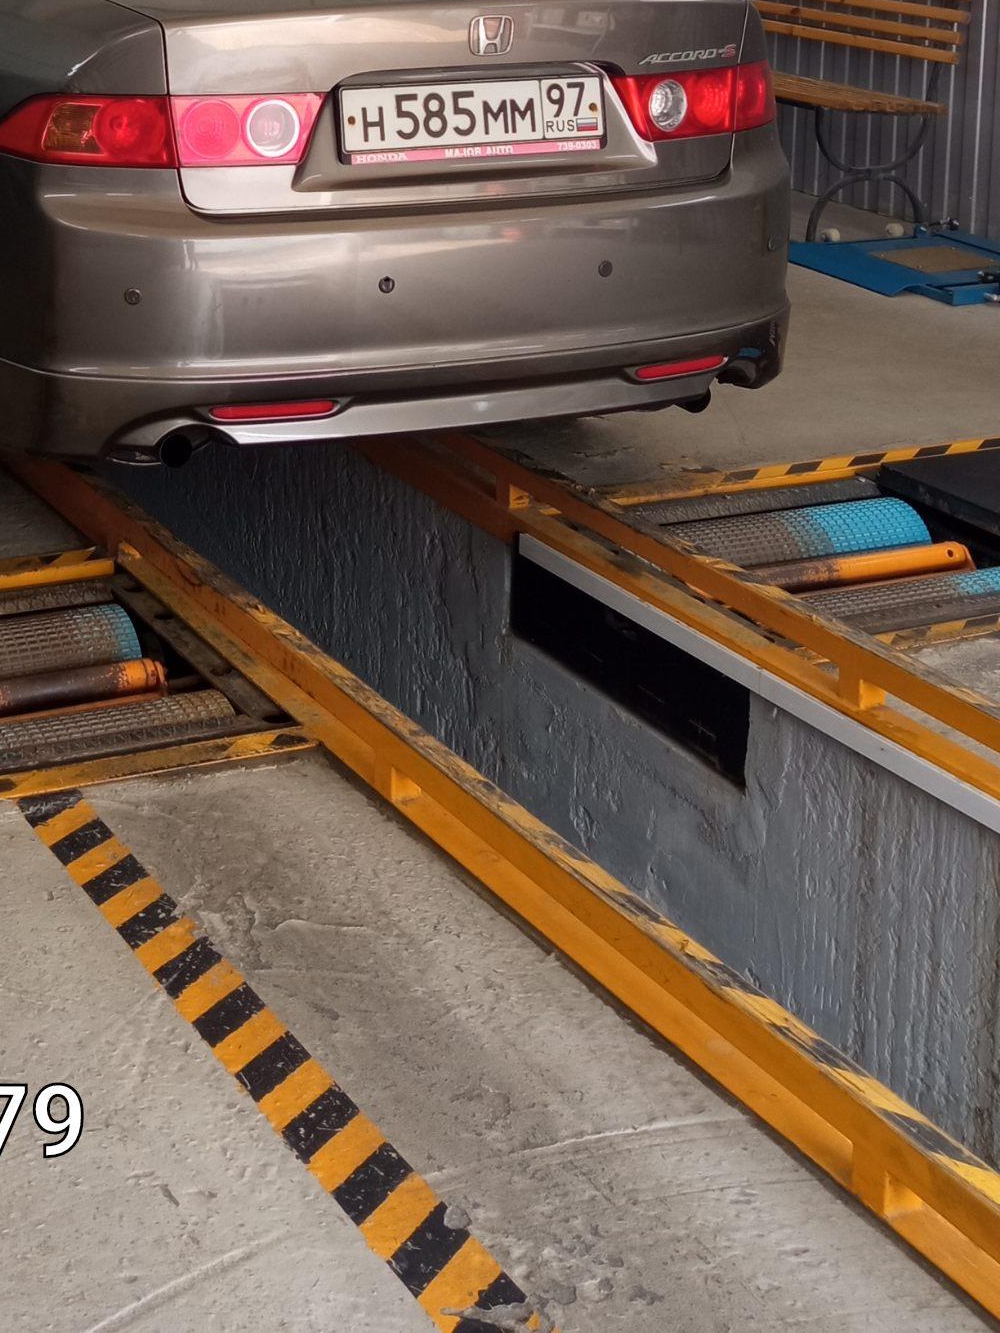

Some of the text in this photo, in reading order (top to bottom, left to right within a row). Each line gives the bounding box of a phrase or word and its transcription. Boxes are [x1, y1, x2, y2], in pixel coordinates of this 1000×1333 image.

[638, 48, 717, 65] ACCORD
[546, 81, 585, 117] 97
[546, 118, 575, 133] RUS
[356, 152, 408, 164] HONDA
[444, 146, 481, 159] MAJOR
[486, 145, 514, 156] AUTO
